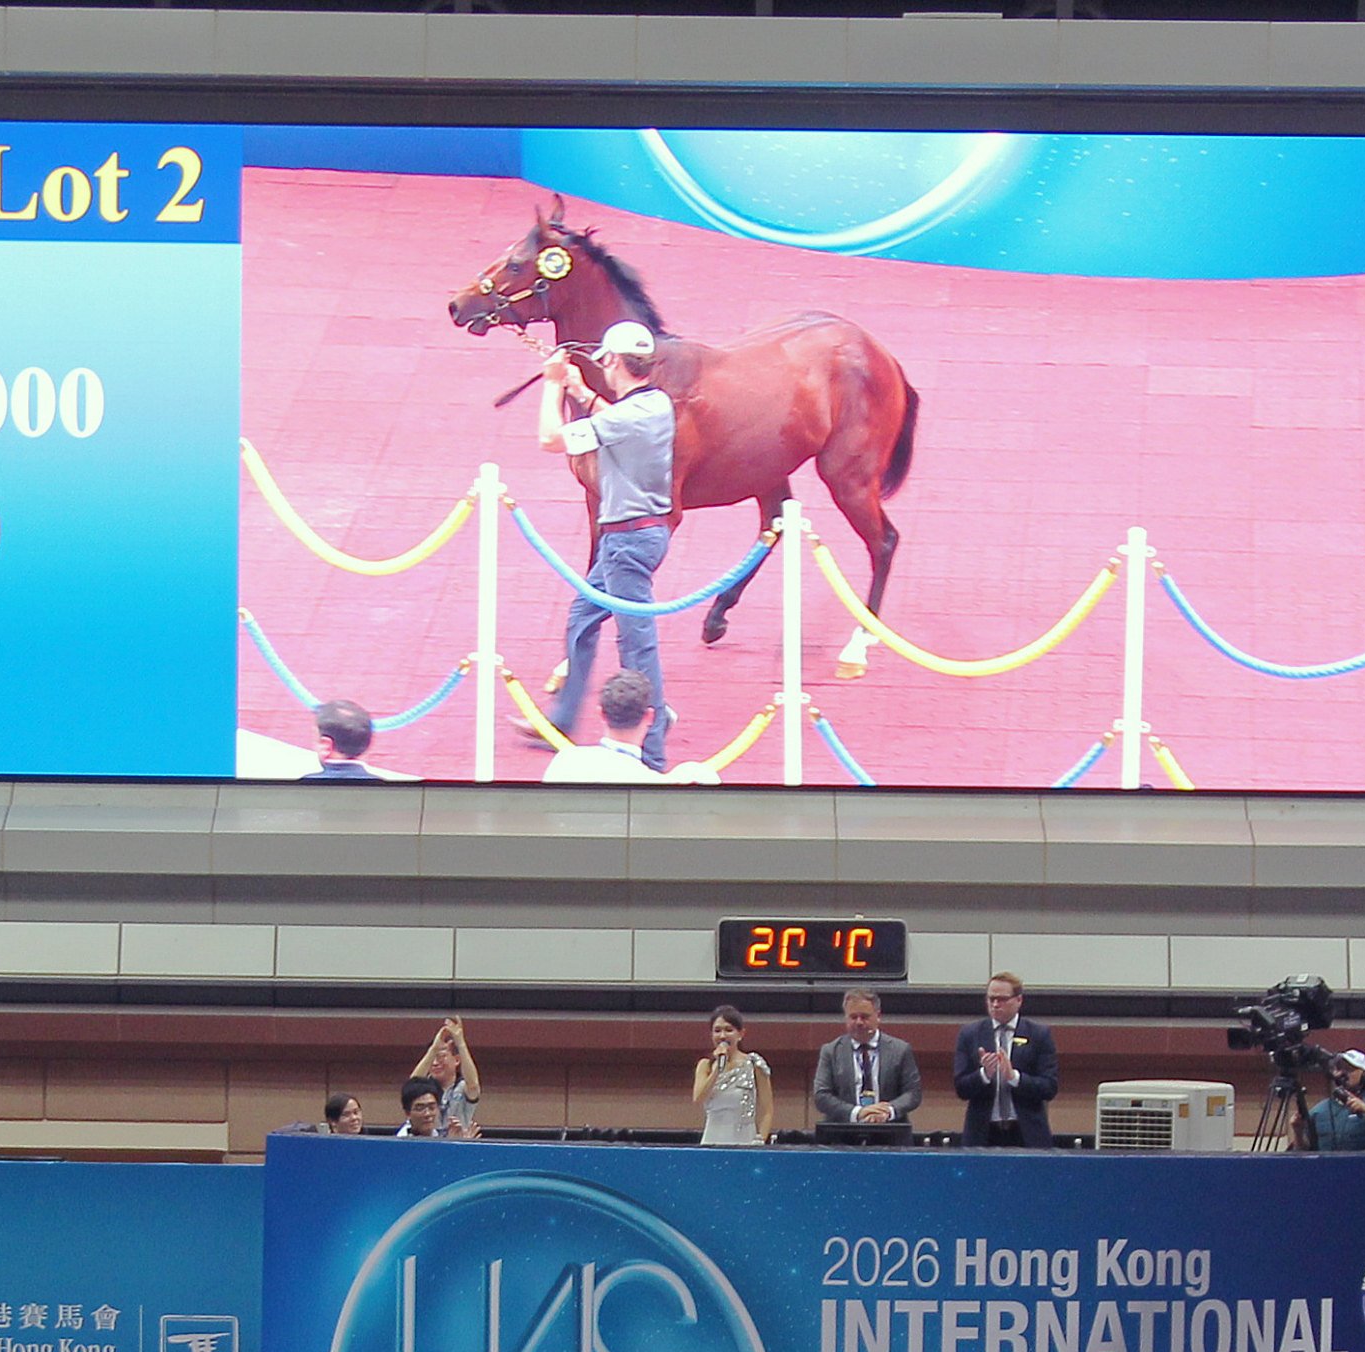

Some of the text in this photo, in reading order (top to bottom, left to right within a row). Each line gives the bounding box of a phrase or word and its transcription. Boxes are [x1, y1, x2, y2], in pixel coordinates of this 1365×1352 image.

[156, 147, 204, 222] 2
[821, 1236, 1211, 1298] 2026 Hong Kong
